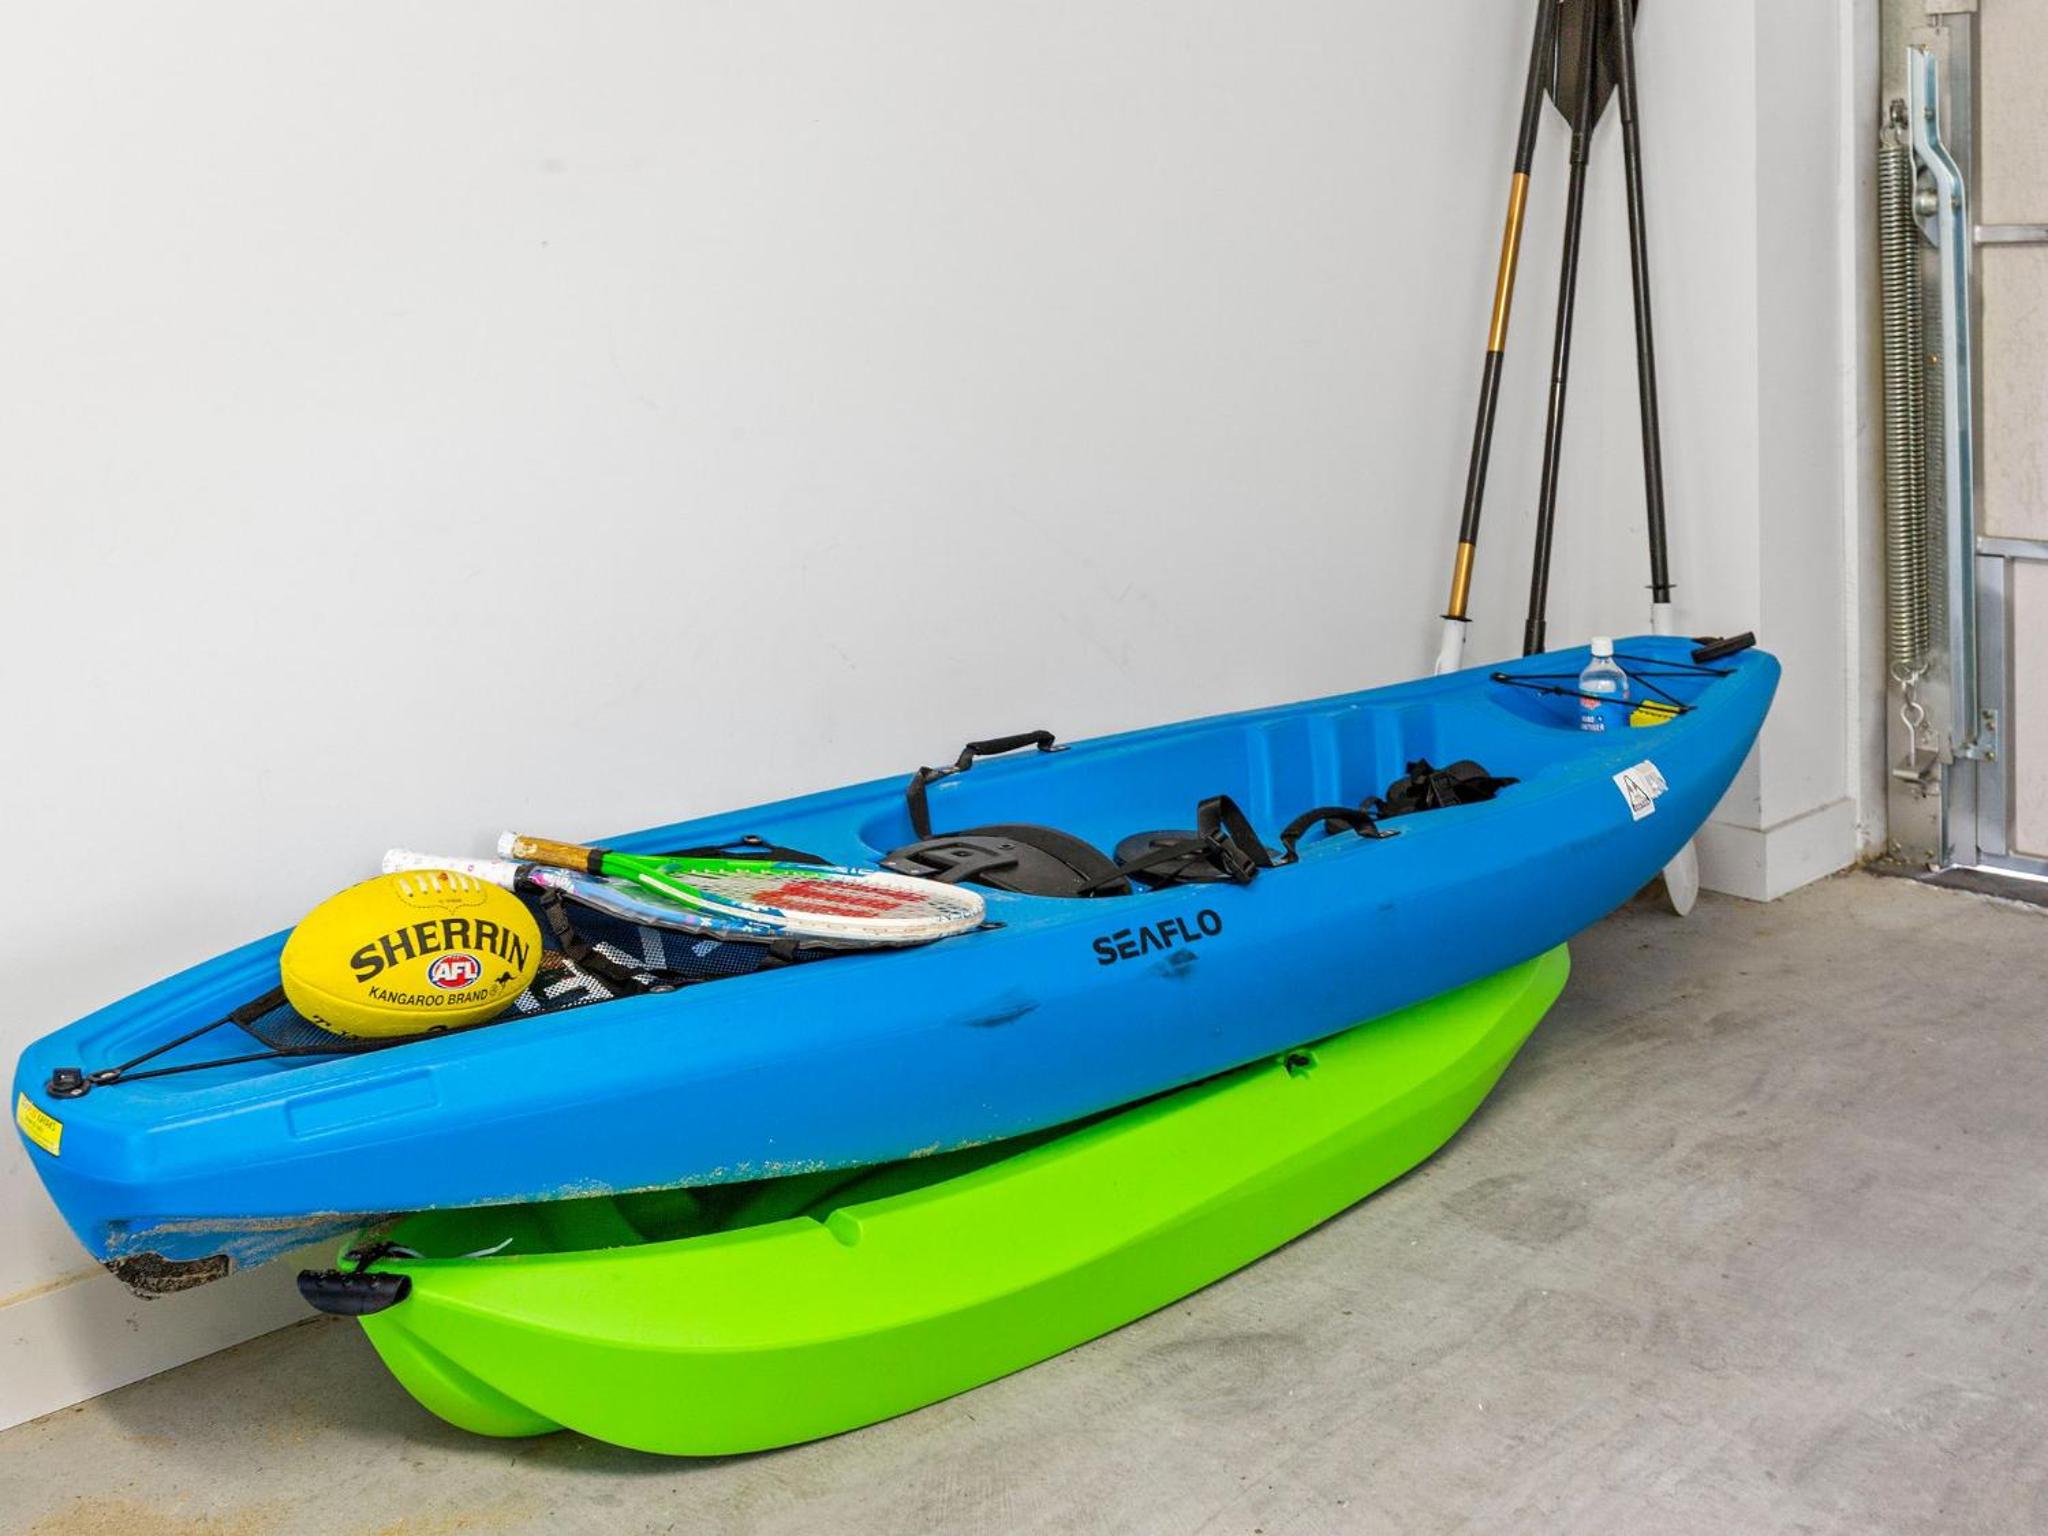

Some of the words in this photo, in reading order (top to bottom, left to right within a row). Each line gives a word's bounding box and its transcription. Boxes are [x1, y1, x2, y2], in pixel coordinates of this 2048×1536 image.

[350, 917, 530, 984] SHERRIN
[1092, 908, 1223, 966] SEAFLO
[432, 961, 477, 983] AFL
[368, 985, 445, 1007] KANGAROO
[447, 989, 489, 1006] BRAND
